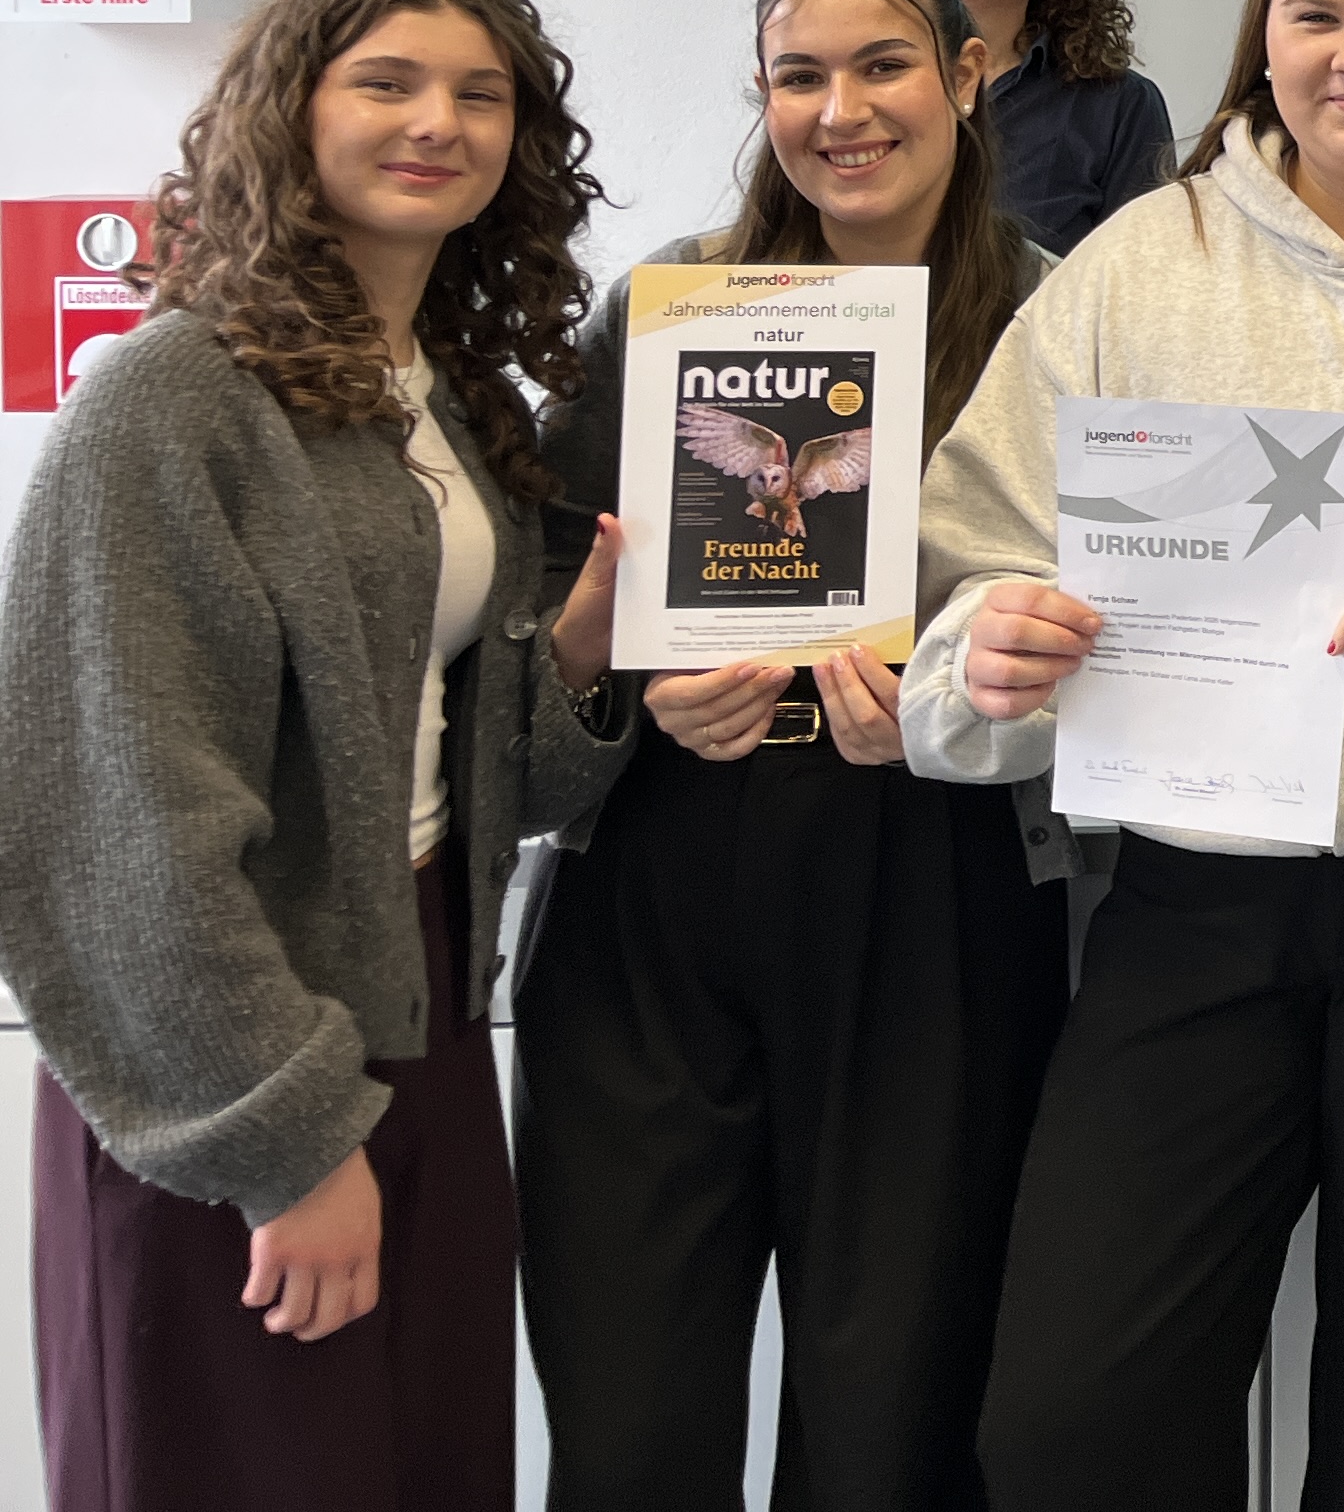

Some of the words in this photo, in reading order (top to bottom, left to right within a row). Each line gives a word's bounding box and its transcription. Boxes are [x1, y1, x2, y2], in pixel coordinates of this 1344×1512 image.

[726, 273, 778, 288] jugend
[791, 274, 835, 286] forscht
[67, 287, 151, 304] Löschdee
[663, 301, 837, 318] Jahresabonnement
[842, 303, 895, 321] digital
[754, 328, 804, 342] natur
[683, 358, 829, 399] natur
[1084, 427, 1135, 444] jugend
[1148, 431, 1192, 446] forscht
[703, 538, 805, 558] Freunde
[1085, 533, 1229, 561] URKUNDE
[702, 561, 744, 581] der
[749, 560, 821, 580] Nacht
